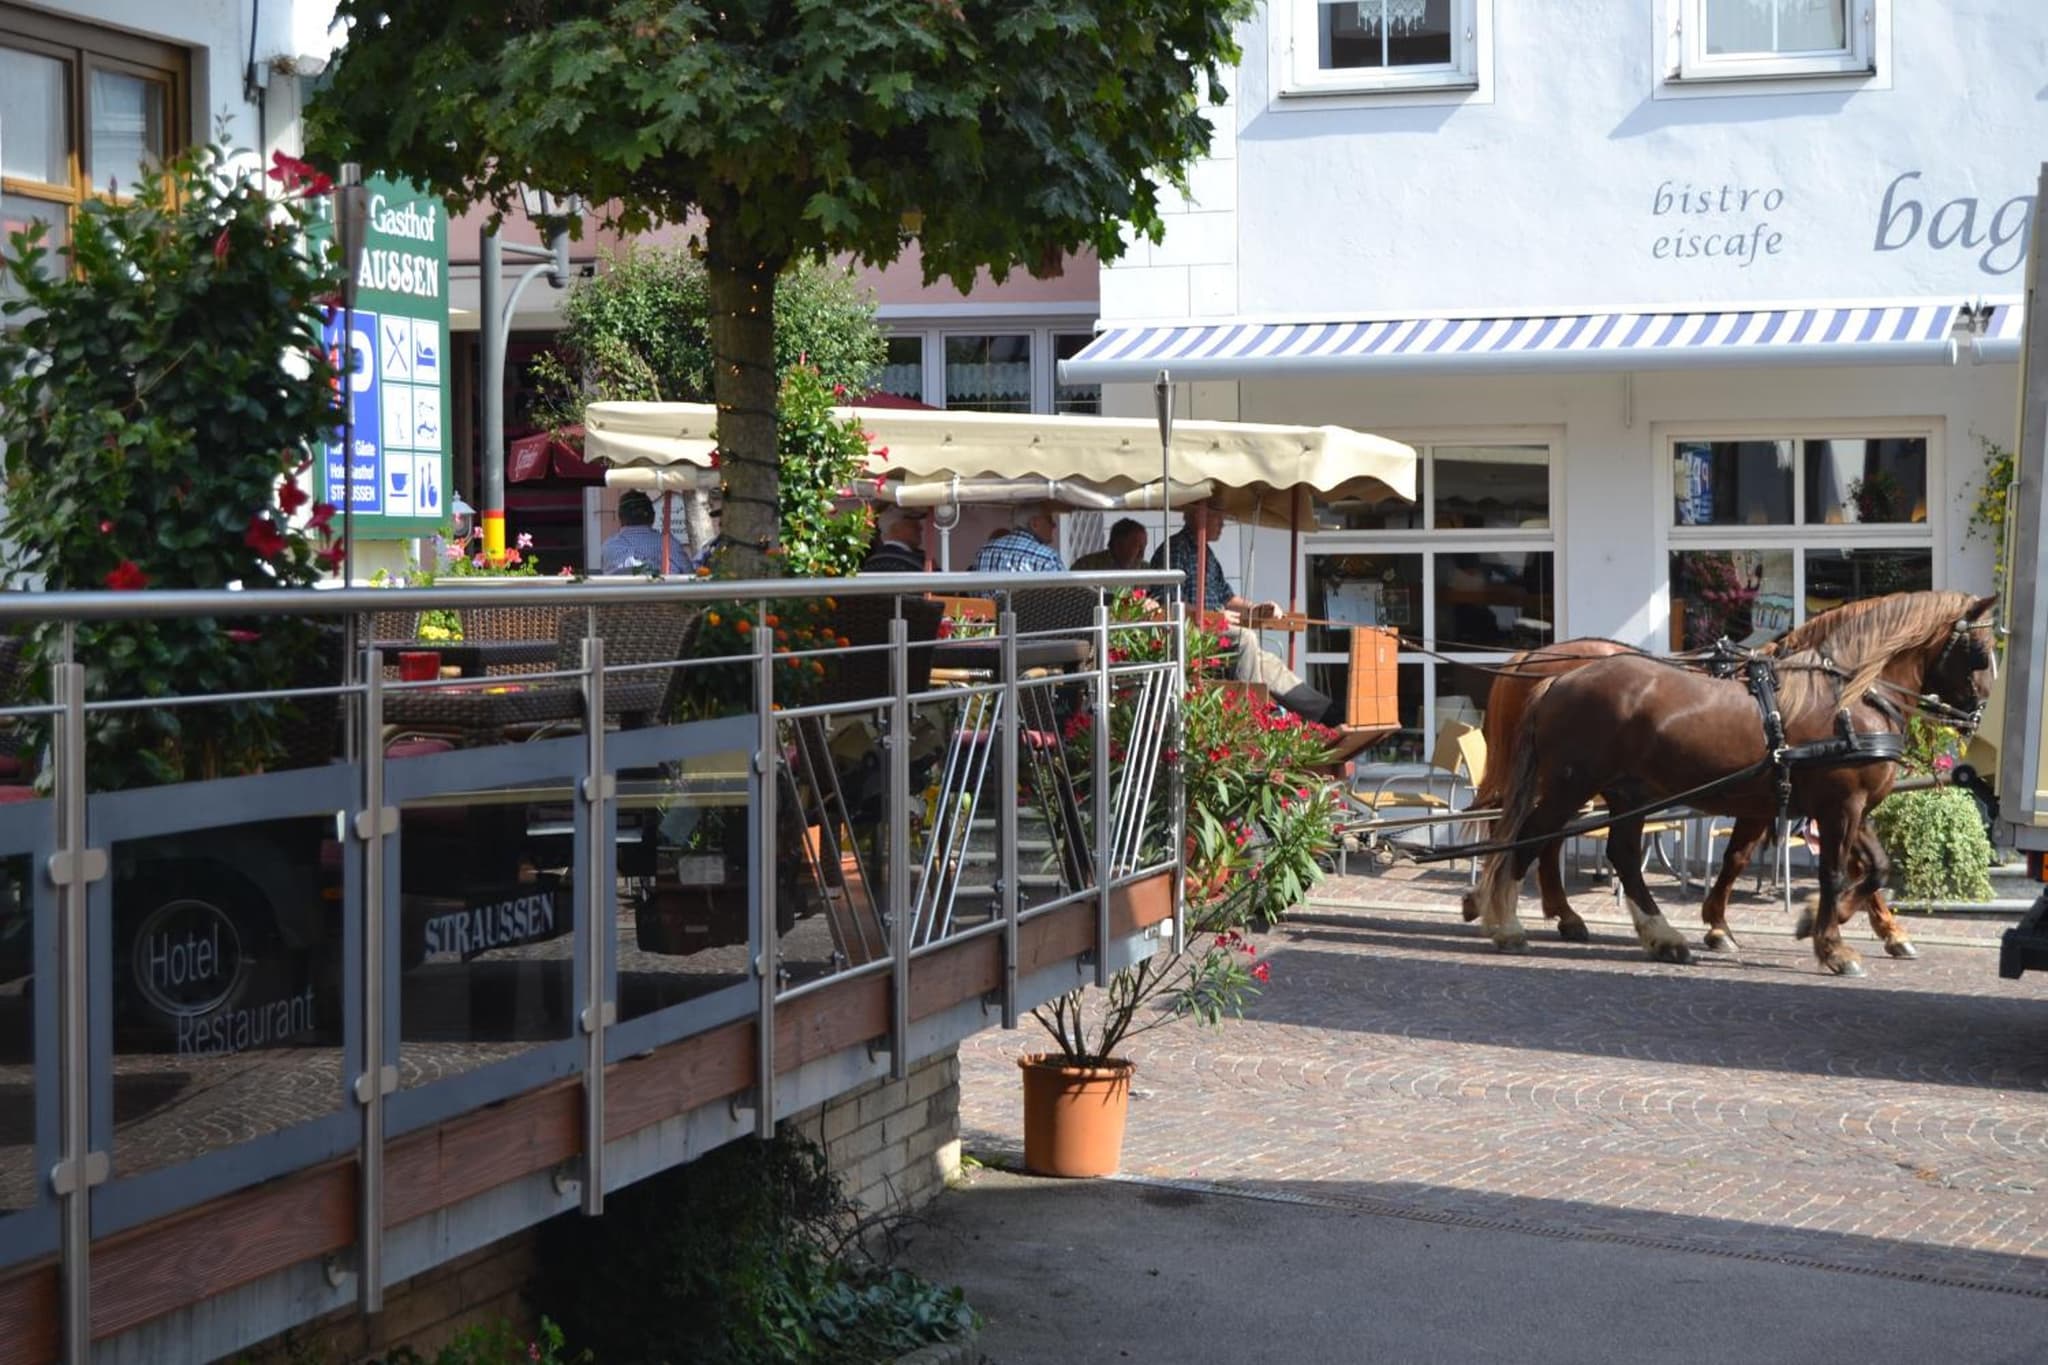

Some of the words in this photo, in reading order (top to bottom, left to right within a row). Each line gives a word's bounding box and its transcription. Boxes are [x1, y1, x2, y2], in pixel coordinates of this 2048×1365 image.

[370, 194, 437, 242] Gasthof
[1652, 180, 1785, 216] bistro
[1652, 223, 1784, 268] eiscafe
[329, 486, 376, 502] STRSSEN
[423, 891, 555, 963] STRAUSSEN
[149, 921, 220, 989] Hotel
[177, 984, 315, 1058] Restaurant
